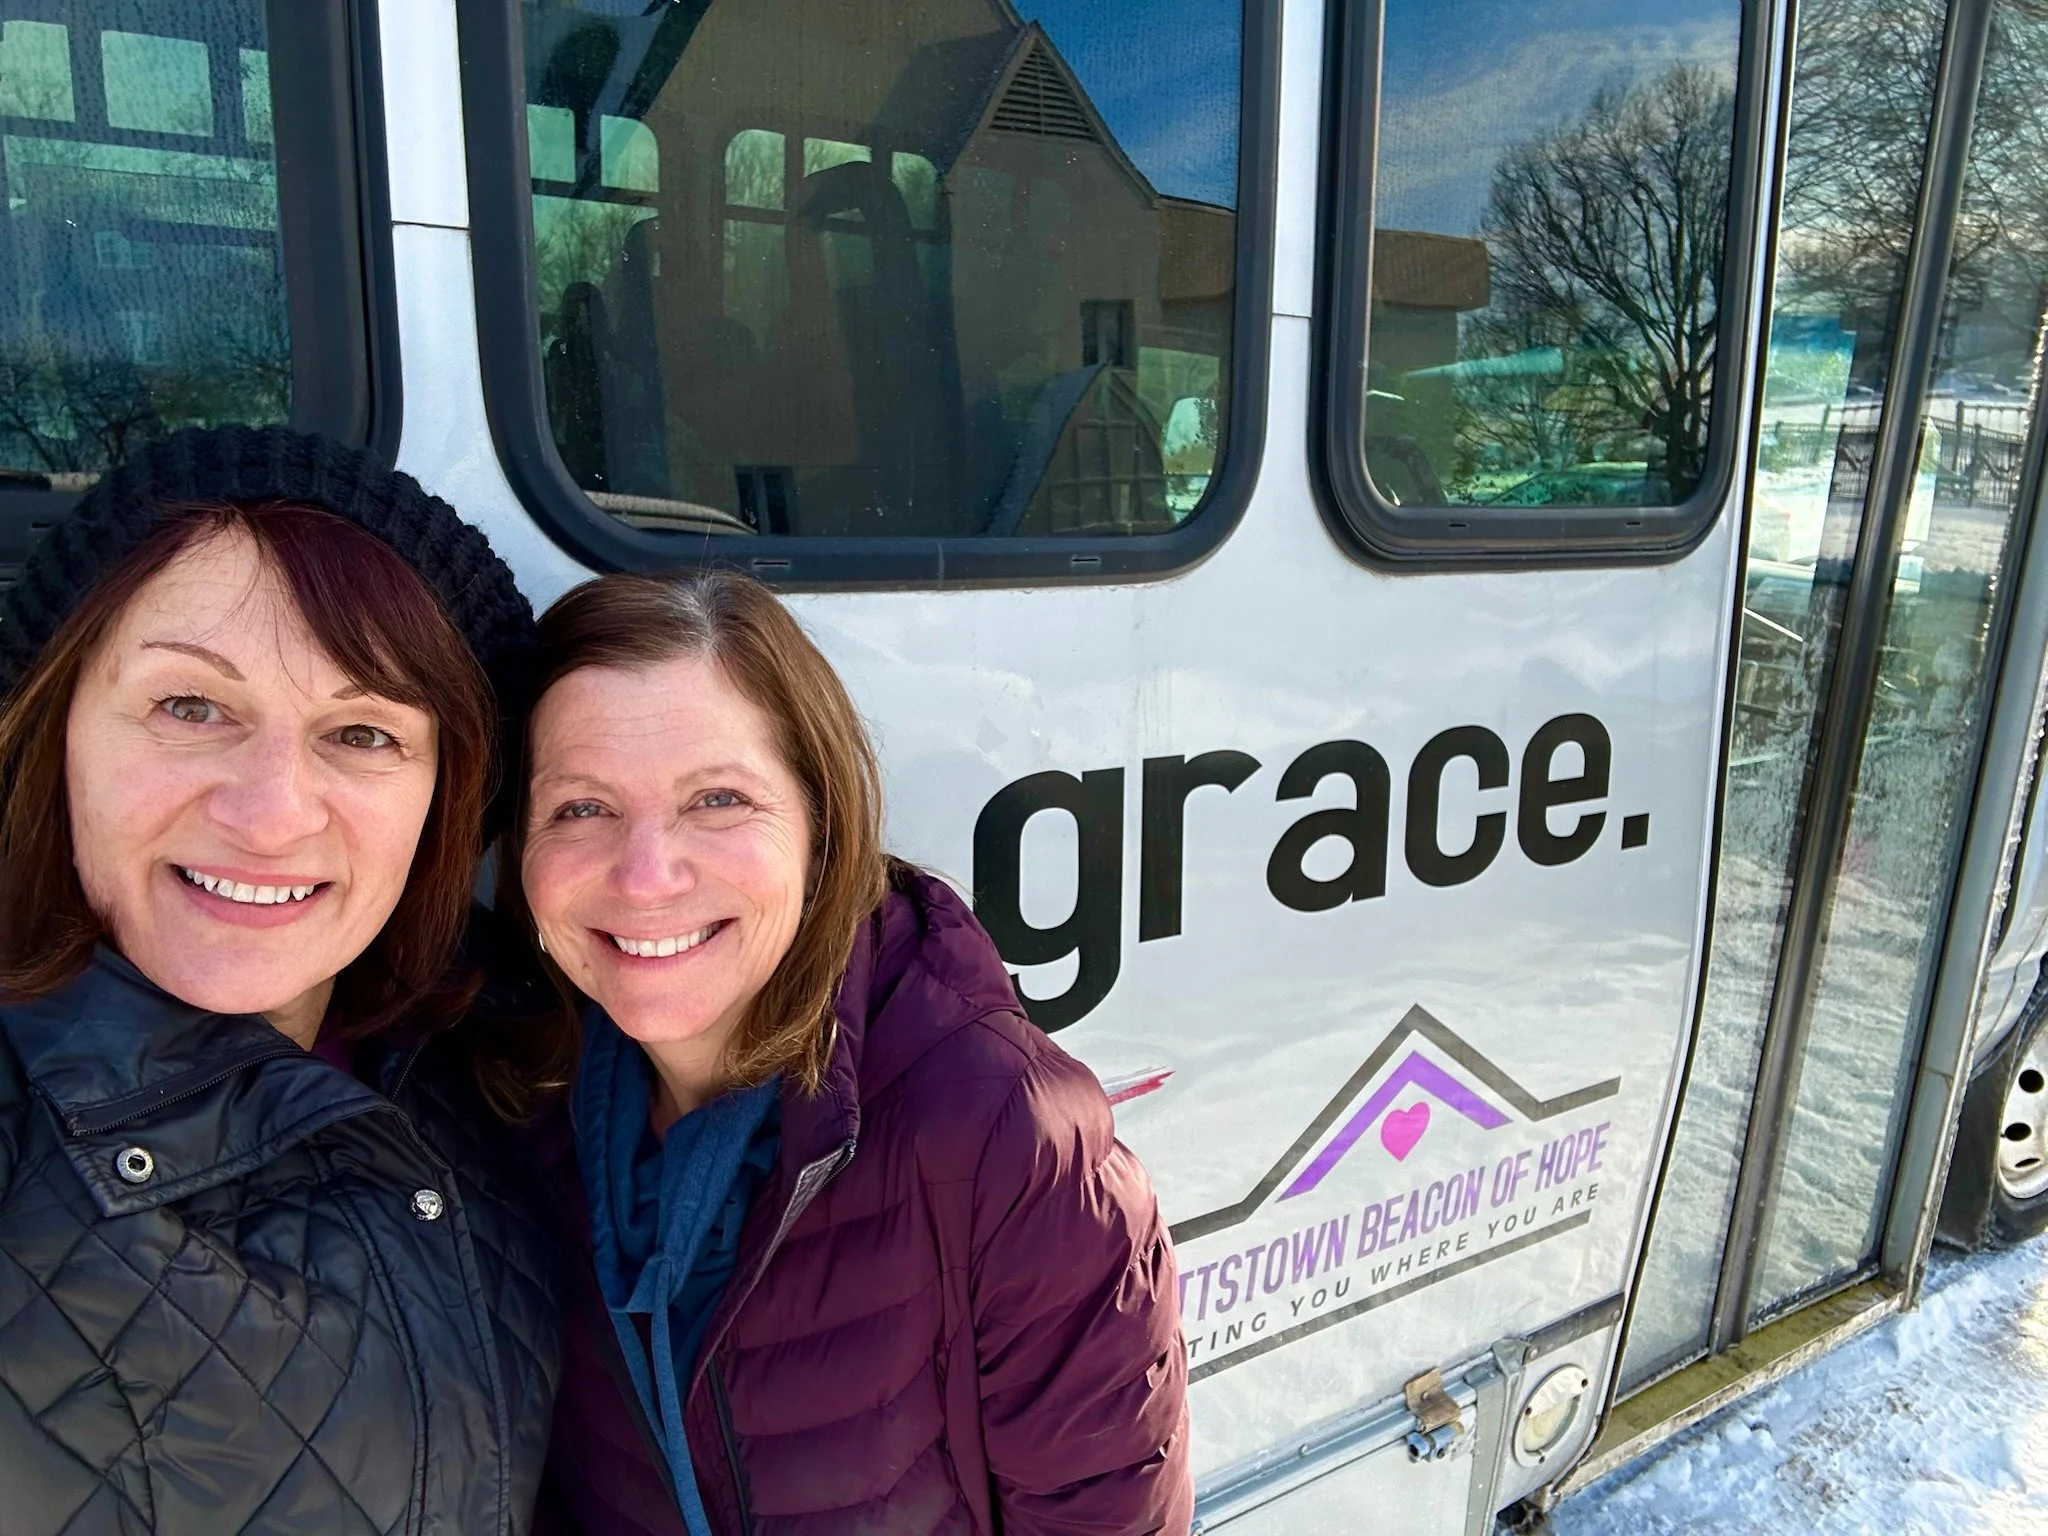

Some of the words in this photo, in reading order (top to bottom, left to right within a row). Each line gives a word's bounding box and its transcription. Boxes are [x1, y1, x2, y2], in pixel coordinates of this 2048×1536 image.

[972, 712, 1650, 1035] grace.
[1187, 1311, 1267, 1358] TING
[1290, 1276, 1350, 1317] YOU
[1371, 1231, 1469, 1286] WHERE
[1487, 1206, 1537, 1239] YOU
[1551, 1183, 1599, 1216] ARE
[1357, 1165, 1486, 1260] BEACON
[1490, 1148, 1533, 1208] OF
[1534, 1121, 1611, 1193] HOPE
